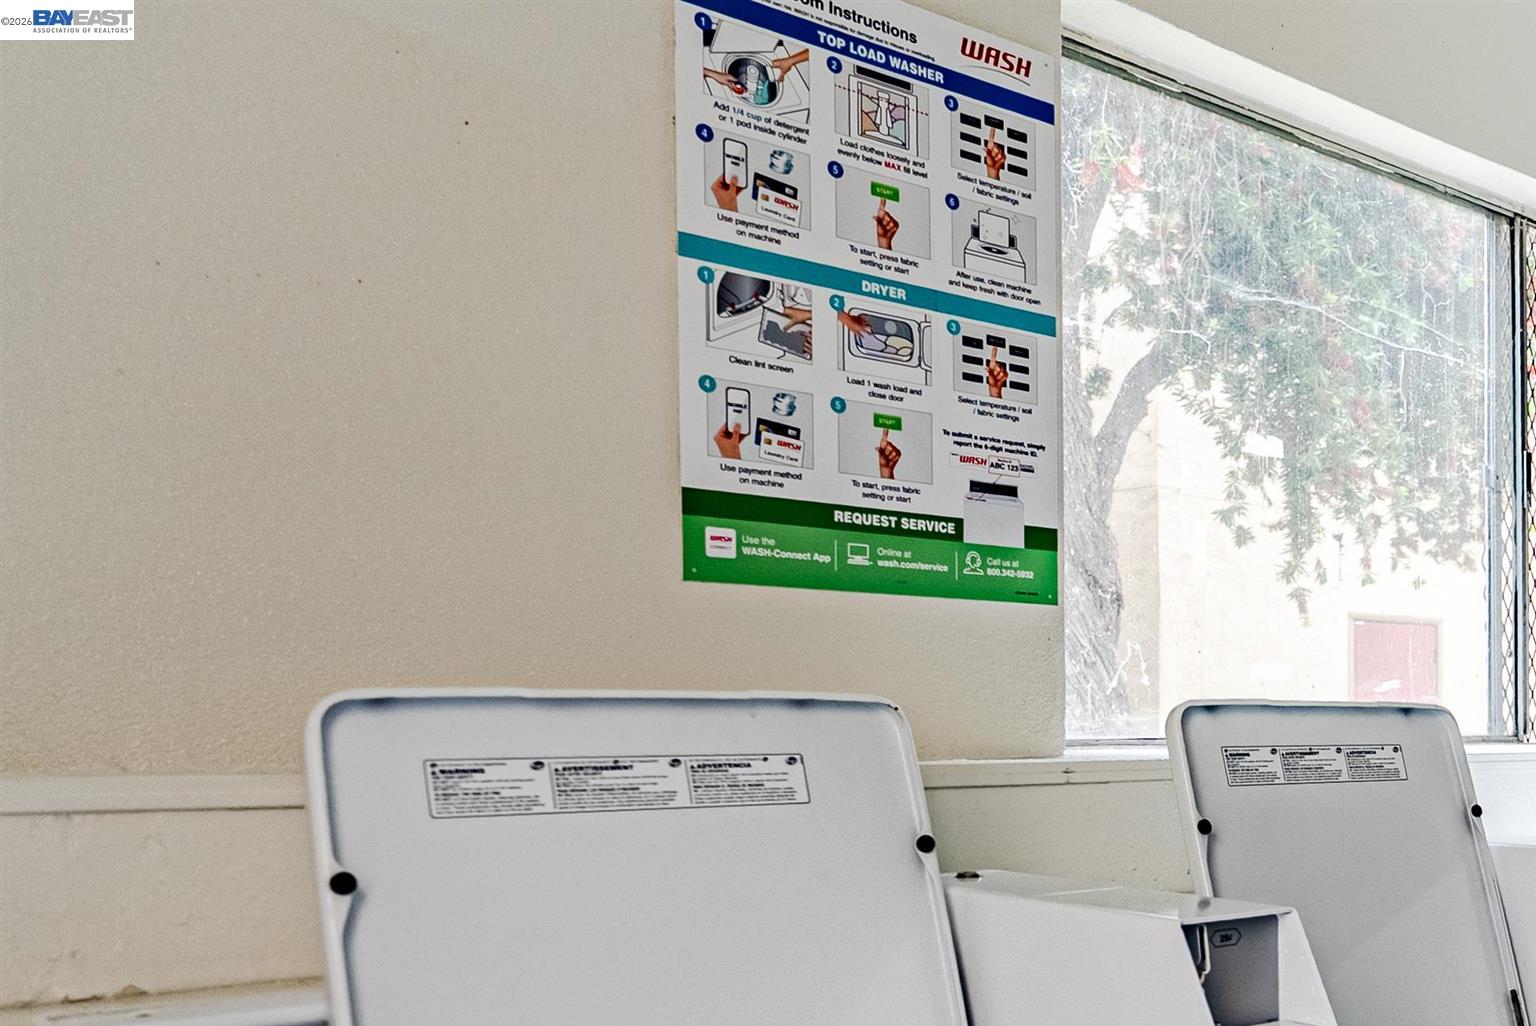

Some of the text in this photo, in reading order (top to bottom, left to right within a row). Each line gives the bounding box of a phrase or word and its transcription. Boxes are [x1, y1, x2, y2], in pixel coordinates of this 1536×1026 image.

[829, 1, 918, 44] Instructions
[817, 30, 944, 84] TOP LOAD WASHER
[960, 37, 1032, 78] WASH
[713, 101, 730, 112] Add
[748, 113, 762, 122] cup
[764, 116, 772, 124] of
[774, 118, 810, 136] detergent
[718, 114, 808, 145] or pod inside cylinder
[837, 148, 860, 160] evenly
[862, 153, 882, 166] below
[884, 161, 901, 172] MAX
[840, 138, 925, 169] Load clothes loosely and
[957, 172, 977, 184] Select
[716, 213, 800, 239] Use payment method
[749, 232, 781, 245] machine
[849, 244, 858, 254] To
[880, 253, 899, 263] press
[900, 256, 919, 268] fabric
[860, 259, 883, 271] setting
[894, 264, 909, 275] start
[861, 279, 906, 300] DRYER
[948, 279, 960, 287] and
[956, 271, 970, 280] After
[1006, 283, 1032, 294] machine
[729, 355, 794, 374] Clean lint screen
[847, 377, 922, 396] Load wash load and
[868, 391, 904, 402] close door
[958, 395, 977, 406] Select
[1004, 447, 1029, 456] machine
[960, 455, 987, 466] WASH
[990, 462, 1005, 470] ABC
[1008, 464, 1018, 472] 123
[720, 464, 802, 480] Use payment method
[752, 479, 784, 488] machine
[882, 485, 901, 493] press
[902, 487, 921, 495] fabric
[862, 492, 885, 502] setting
[834, 510, 956, 534] REQUEST SERVICE
[742, 534, 759, 544] Use
[762, 536, 775, 545] the
[741, 546, 831, 563] WASH-Connect App
[877, 548, 902, 557] Online
[987, 558, 1000, 566] Call
